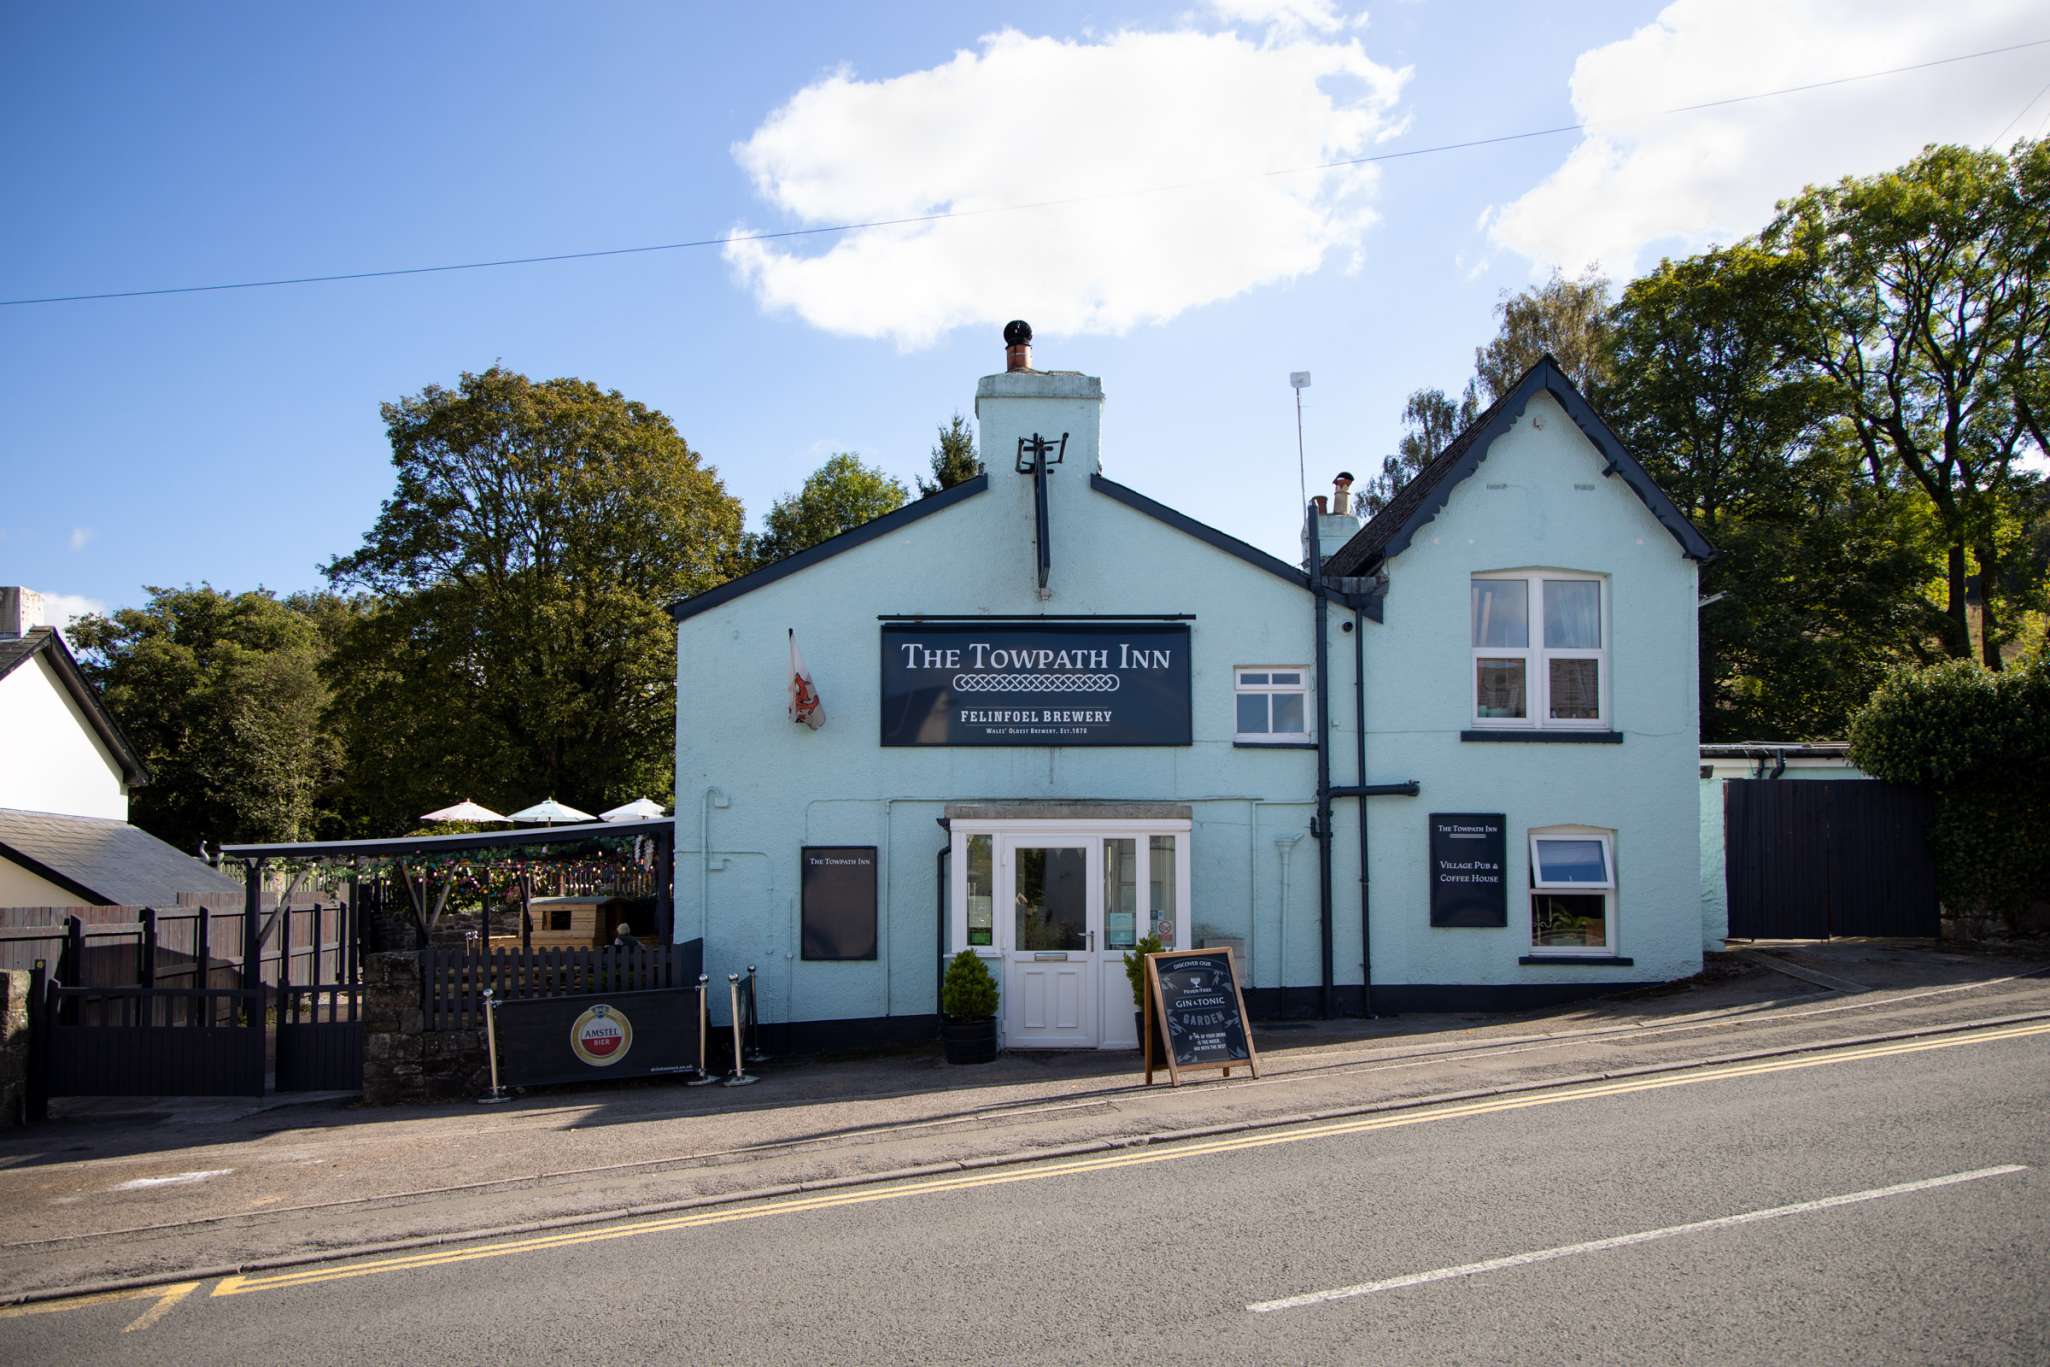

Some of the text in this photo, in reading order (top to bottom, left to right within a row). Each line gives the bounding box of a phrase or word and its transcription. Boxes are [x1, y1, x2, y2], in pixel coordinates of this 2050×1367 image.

[901, 643, 1172, 669] THE TOWPATH INN
[960, 710, 1112, 723] FELINFOEL BREWERY
[1440, 861, 1473, 869] VILLAGE
[1474, 861, 1491, 869] PUB
[1440, 873, 1499, 883] COFFEE HOUSE
[1183, 1011, 1224, 1025] GARDEN
[585, 1028, 617, 1038] AMSTEL
